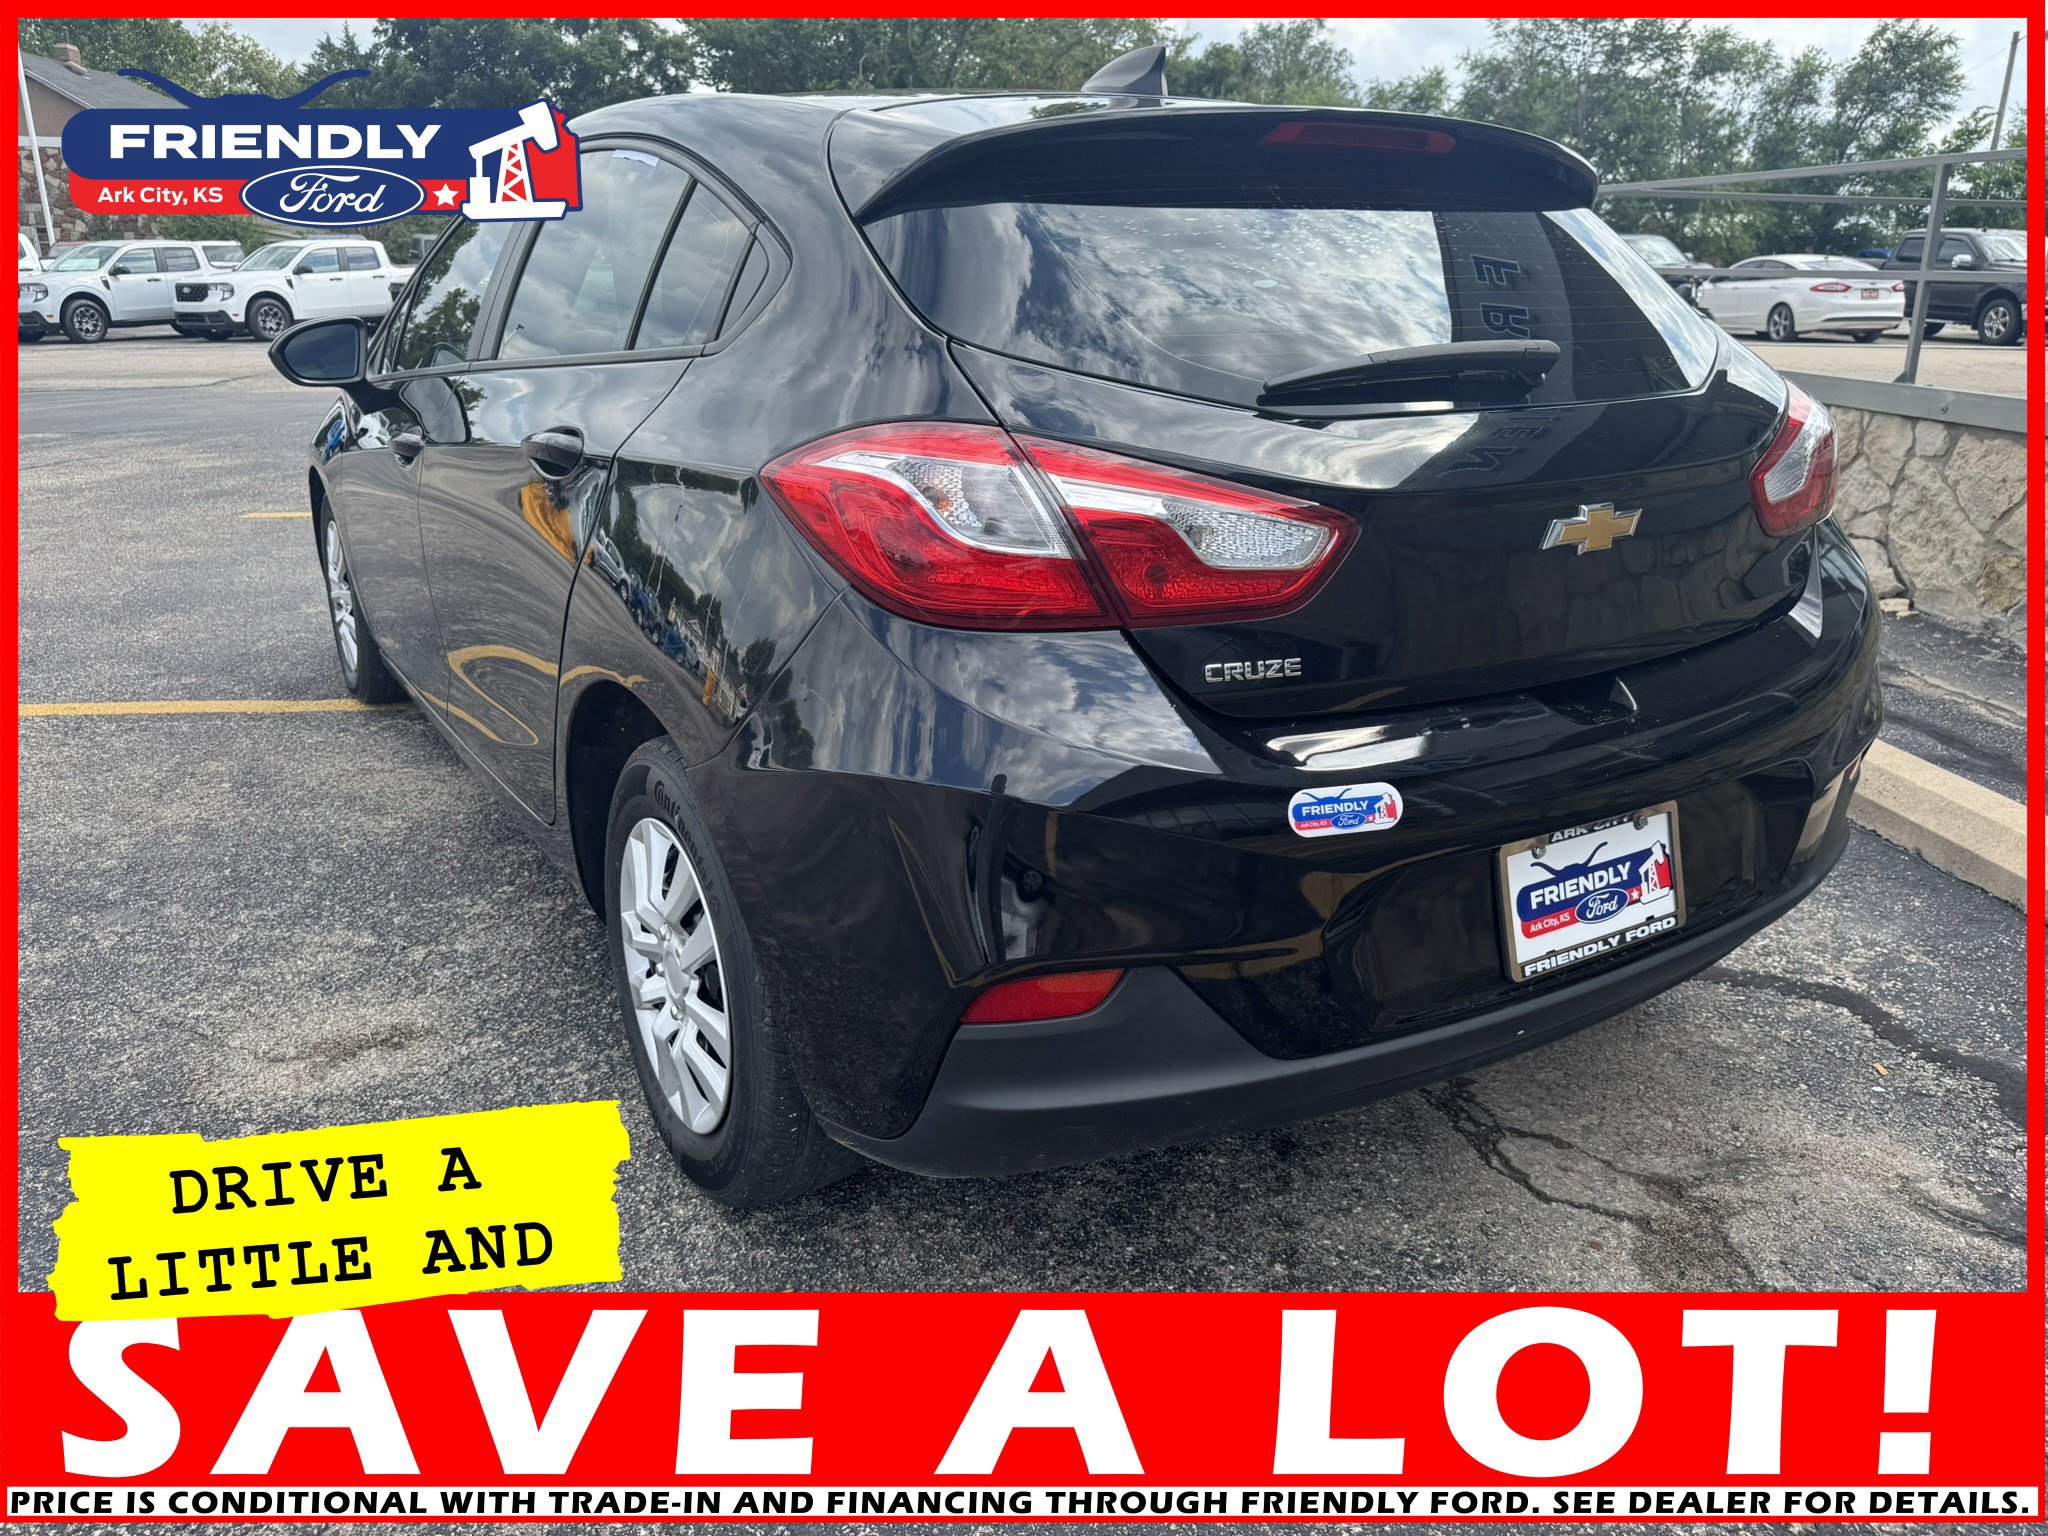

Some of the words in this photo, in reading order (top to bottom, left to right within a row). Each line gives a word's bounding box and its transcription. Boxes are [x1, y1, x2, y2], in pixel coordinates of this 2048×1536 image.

[1205, 658, 1301, 682] CRUZE
[1301, 800, 1368, 817] FRIENDLY
[1338, 814, 1359, 827] Ford
[1530, 861, 1631, 910] FRIENDLY
[1586, 893, 1618, 919] Ford
[1530, 921, 1543, 933] Ark
[1560, 912, 1571, 923] KS
[1524, 934, 1621, 978] FRIENDLY
[1626, 916, 1677, 942] FORD
